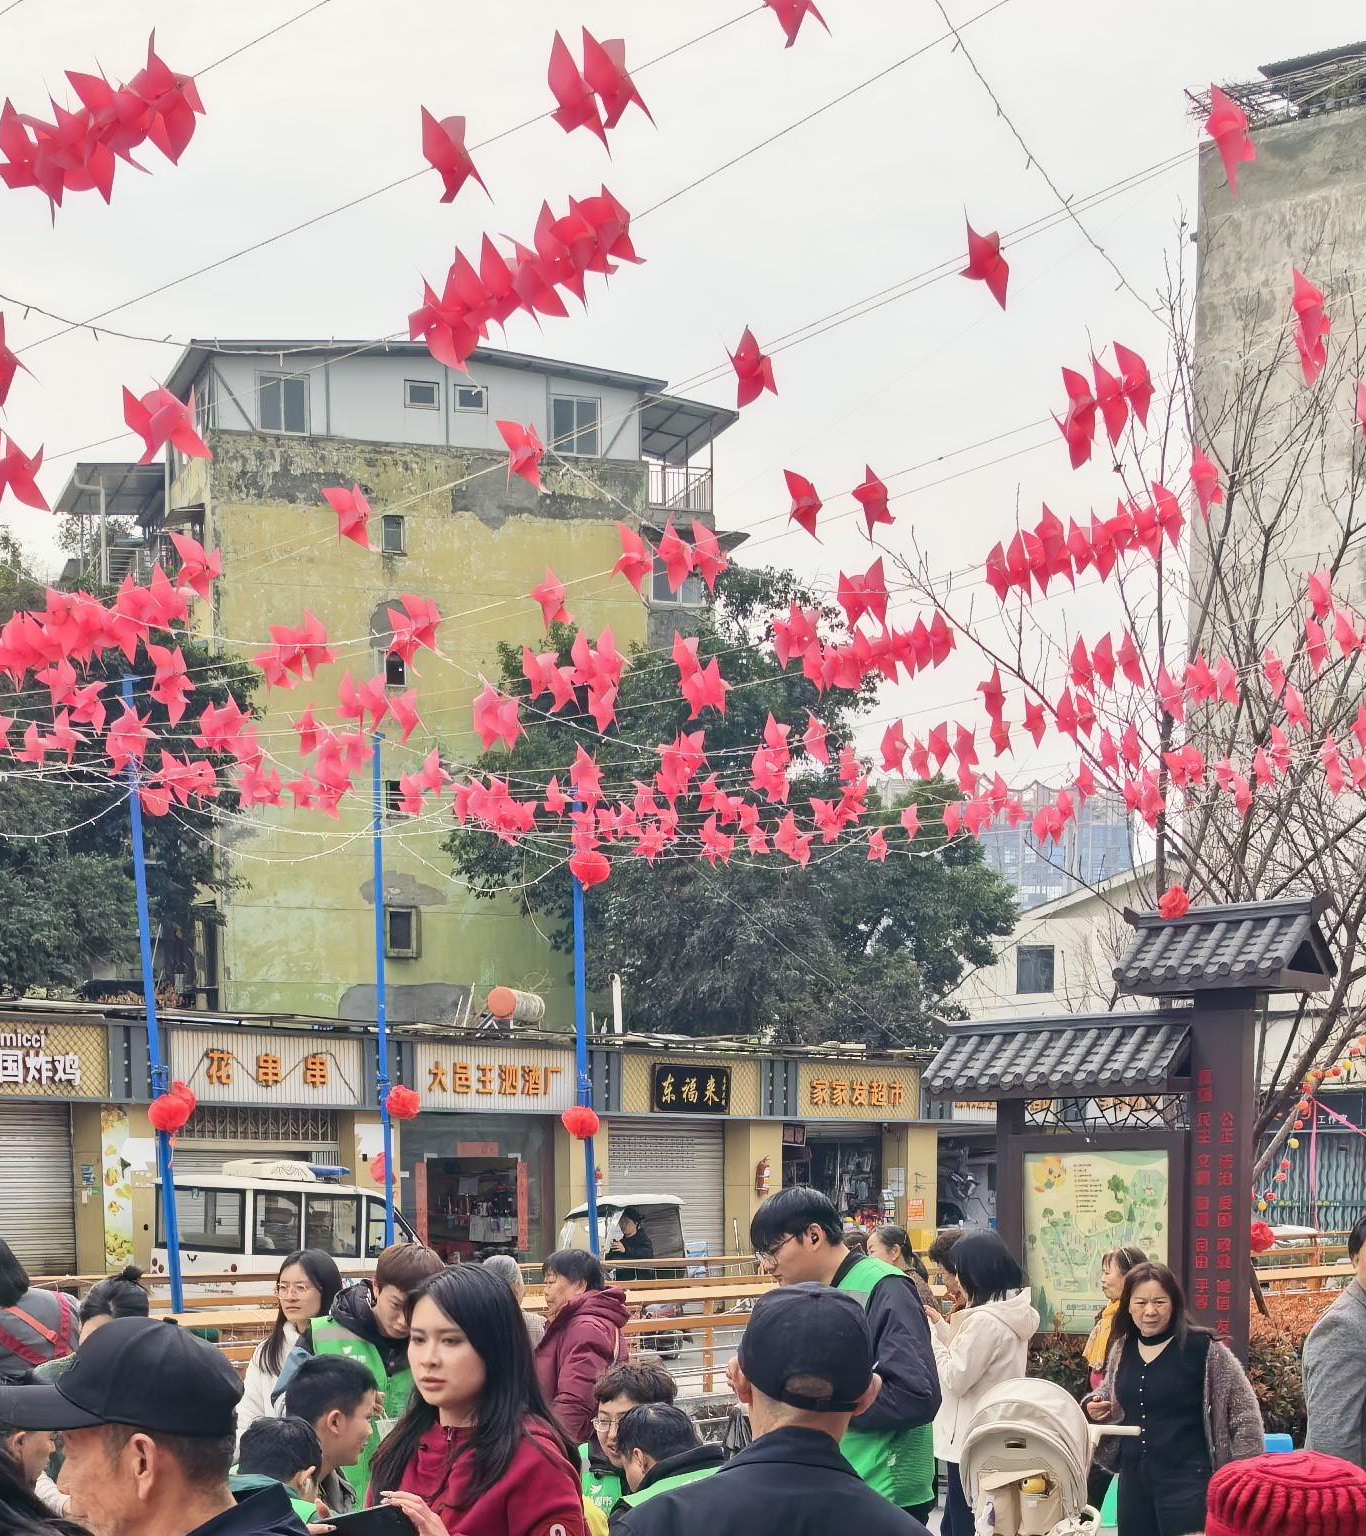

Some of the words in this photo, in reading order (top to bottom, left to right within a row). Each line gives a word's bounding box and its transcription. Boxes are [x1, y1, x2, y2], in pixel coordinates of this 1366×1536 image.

[206, 1049, 328, 1088] 花串串
[428, 1061, 562, 1096] 大邑王泗酒厂
[810, 1079, 905, 1106] 家家发超市
